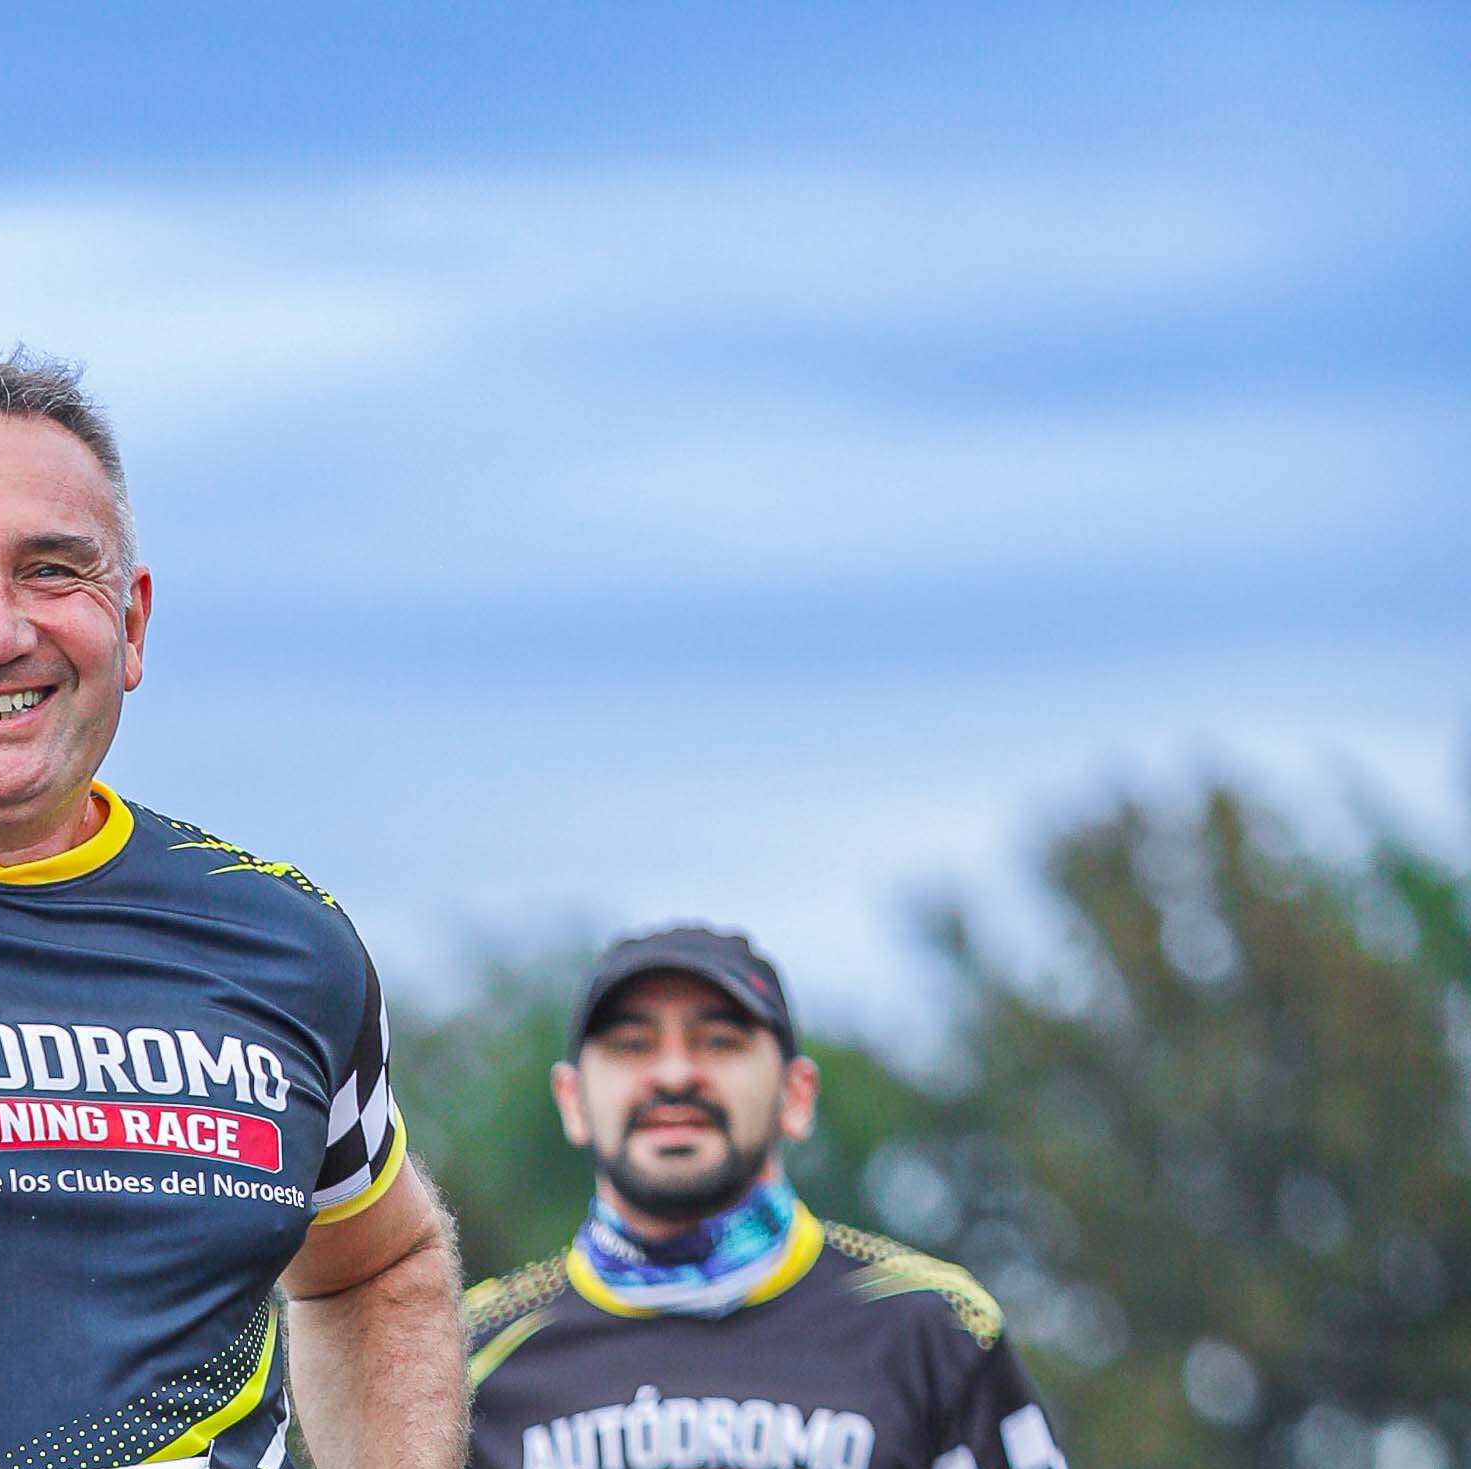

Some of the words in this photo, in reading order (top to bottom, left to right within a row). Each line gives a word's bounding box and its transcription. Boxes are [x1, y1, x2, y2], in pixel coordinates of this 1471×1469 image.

[119, 1108, 240, 1158] RACE
[8, 1168, 51, 1193] los
[57, 1169, 154, 1193] Clubes
[161, 1171, 206, 1196] del
[213, 1174, 306, 1209] Noroeste
